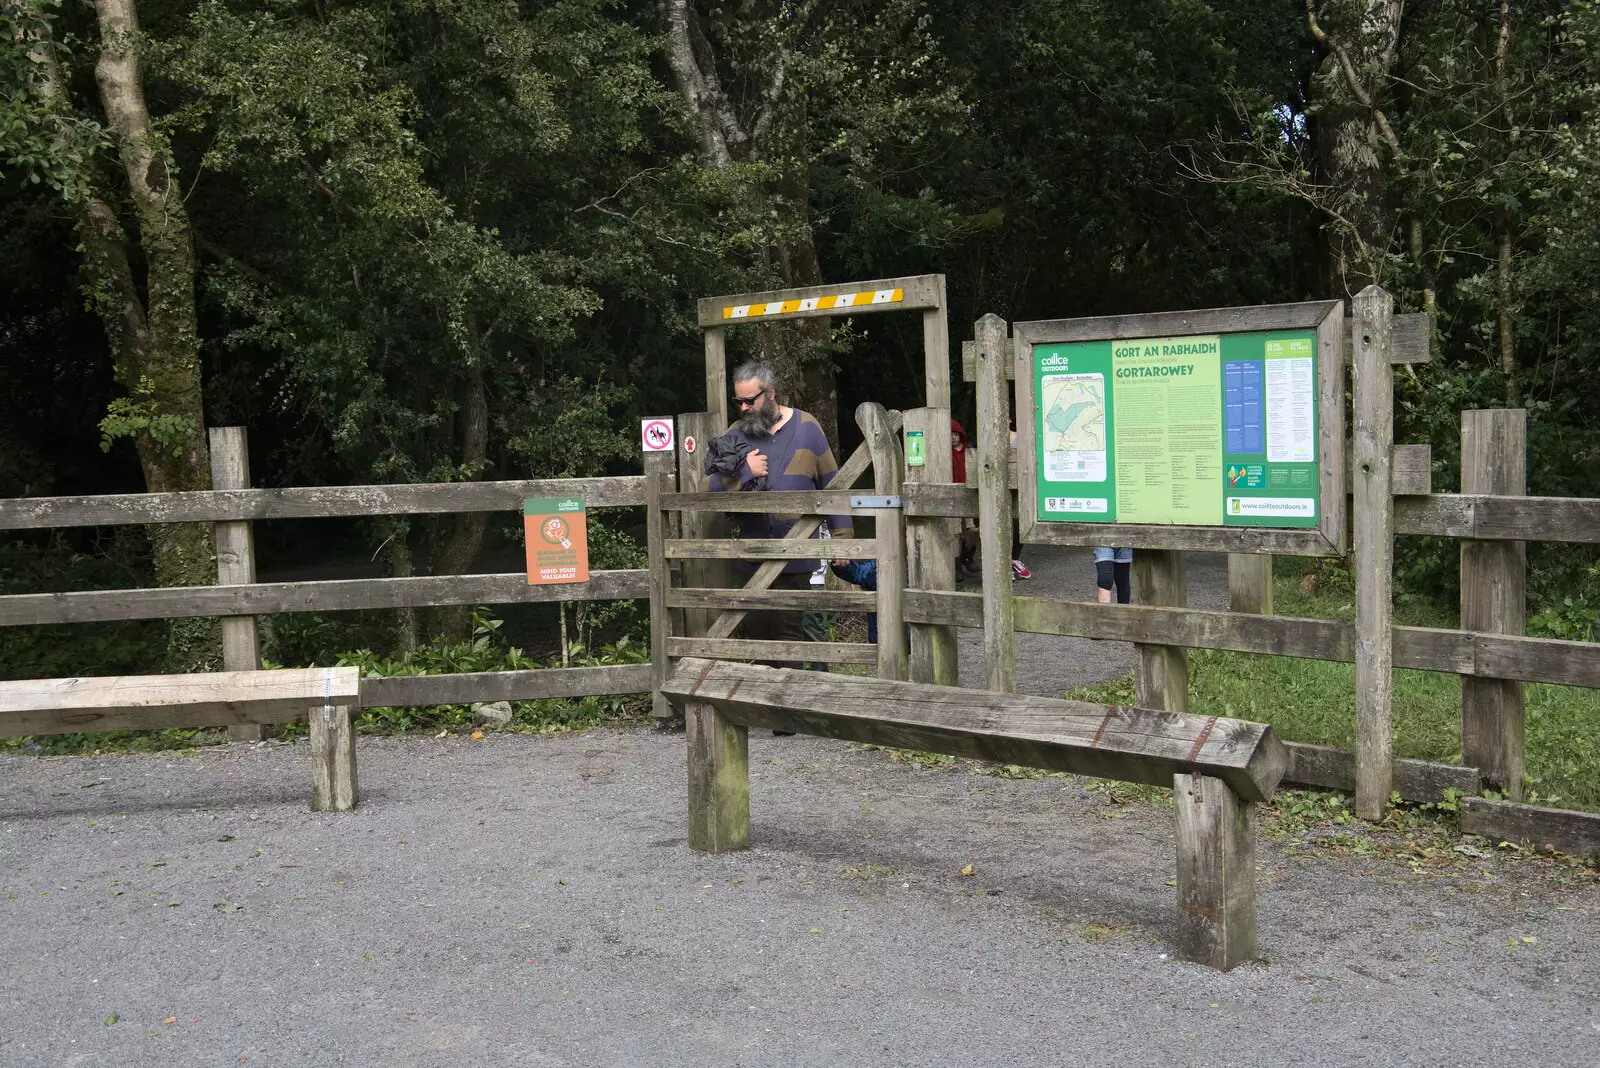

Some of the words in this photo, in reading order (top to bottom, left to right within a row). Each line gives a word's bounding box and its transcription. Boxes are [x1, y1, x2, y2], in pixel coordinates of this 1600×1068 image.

[1115, 347, 1140, 358] GORT
[1144, 346, 1159, 357] AN
[1162, 343, 1216, 356] RABHAIDH
[1116, 364, 1195, 378] GORTAROWEY
